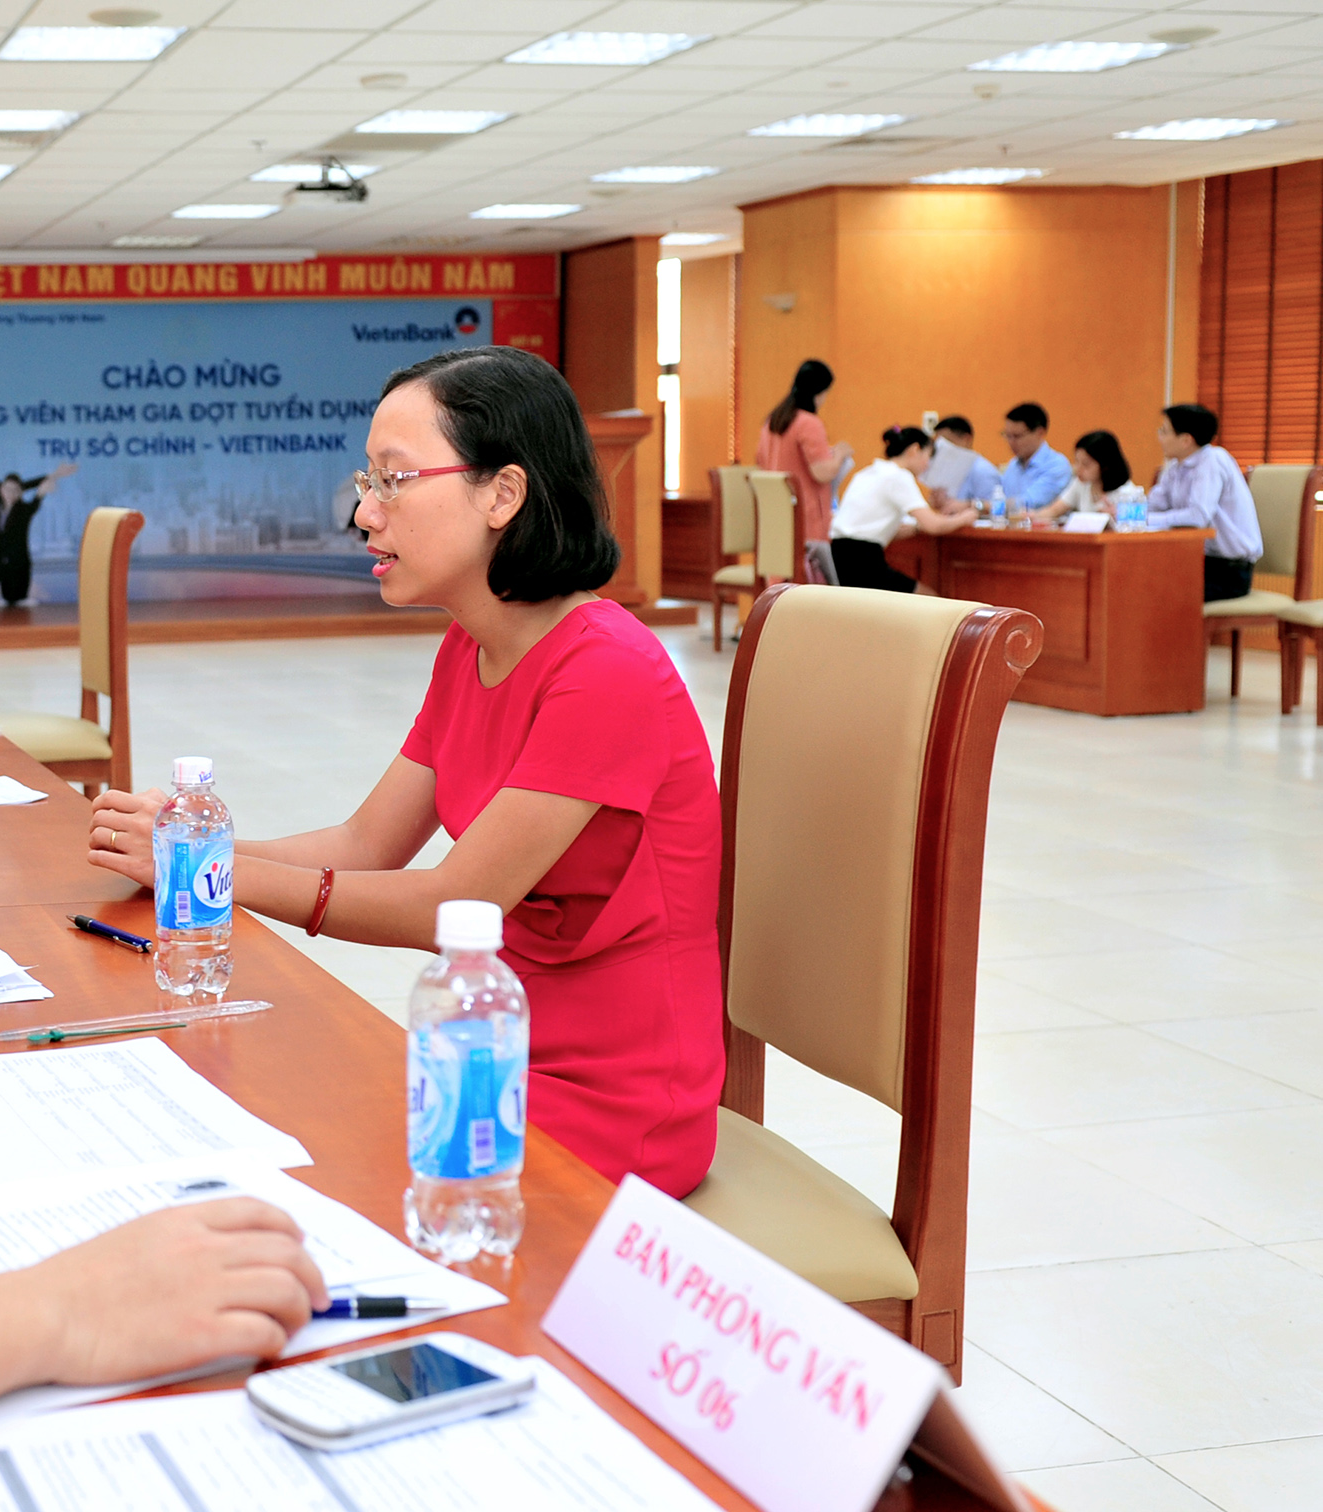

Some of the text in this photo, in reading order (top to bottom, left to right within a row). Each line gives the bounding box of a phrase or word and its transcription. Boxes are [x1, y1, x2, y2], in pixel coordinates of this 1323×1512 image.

[38, 265, 115, 294] NAM
[127, 263, 238, 294] QUANG
[250, 263, 327, 293] VINH
[339, 256, 432, 292] MUÔN
[443, 258, 515, 291] NĂM
[351, 323, 457, 342] VietinBank
[102, 358, 282, 390] CHÀO MỪNG
[14, 400, 66, 425] VIÊN
[72, 403, 136, 424] THAM
[142, 402, 183, 423] GIA
[38, 438, 80, 460] TRỤ
[125, 431, 196, 457] CHÍNH
[219, 433, 347, 456] VIETINBANK
[696, 1376, 740, 1432] 06
